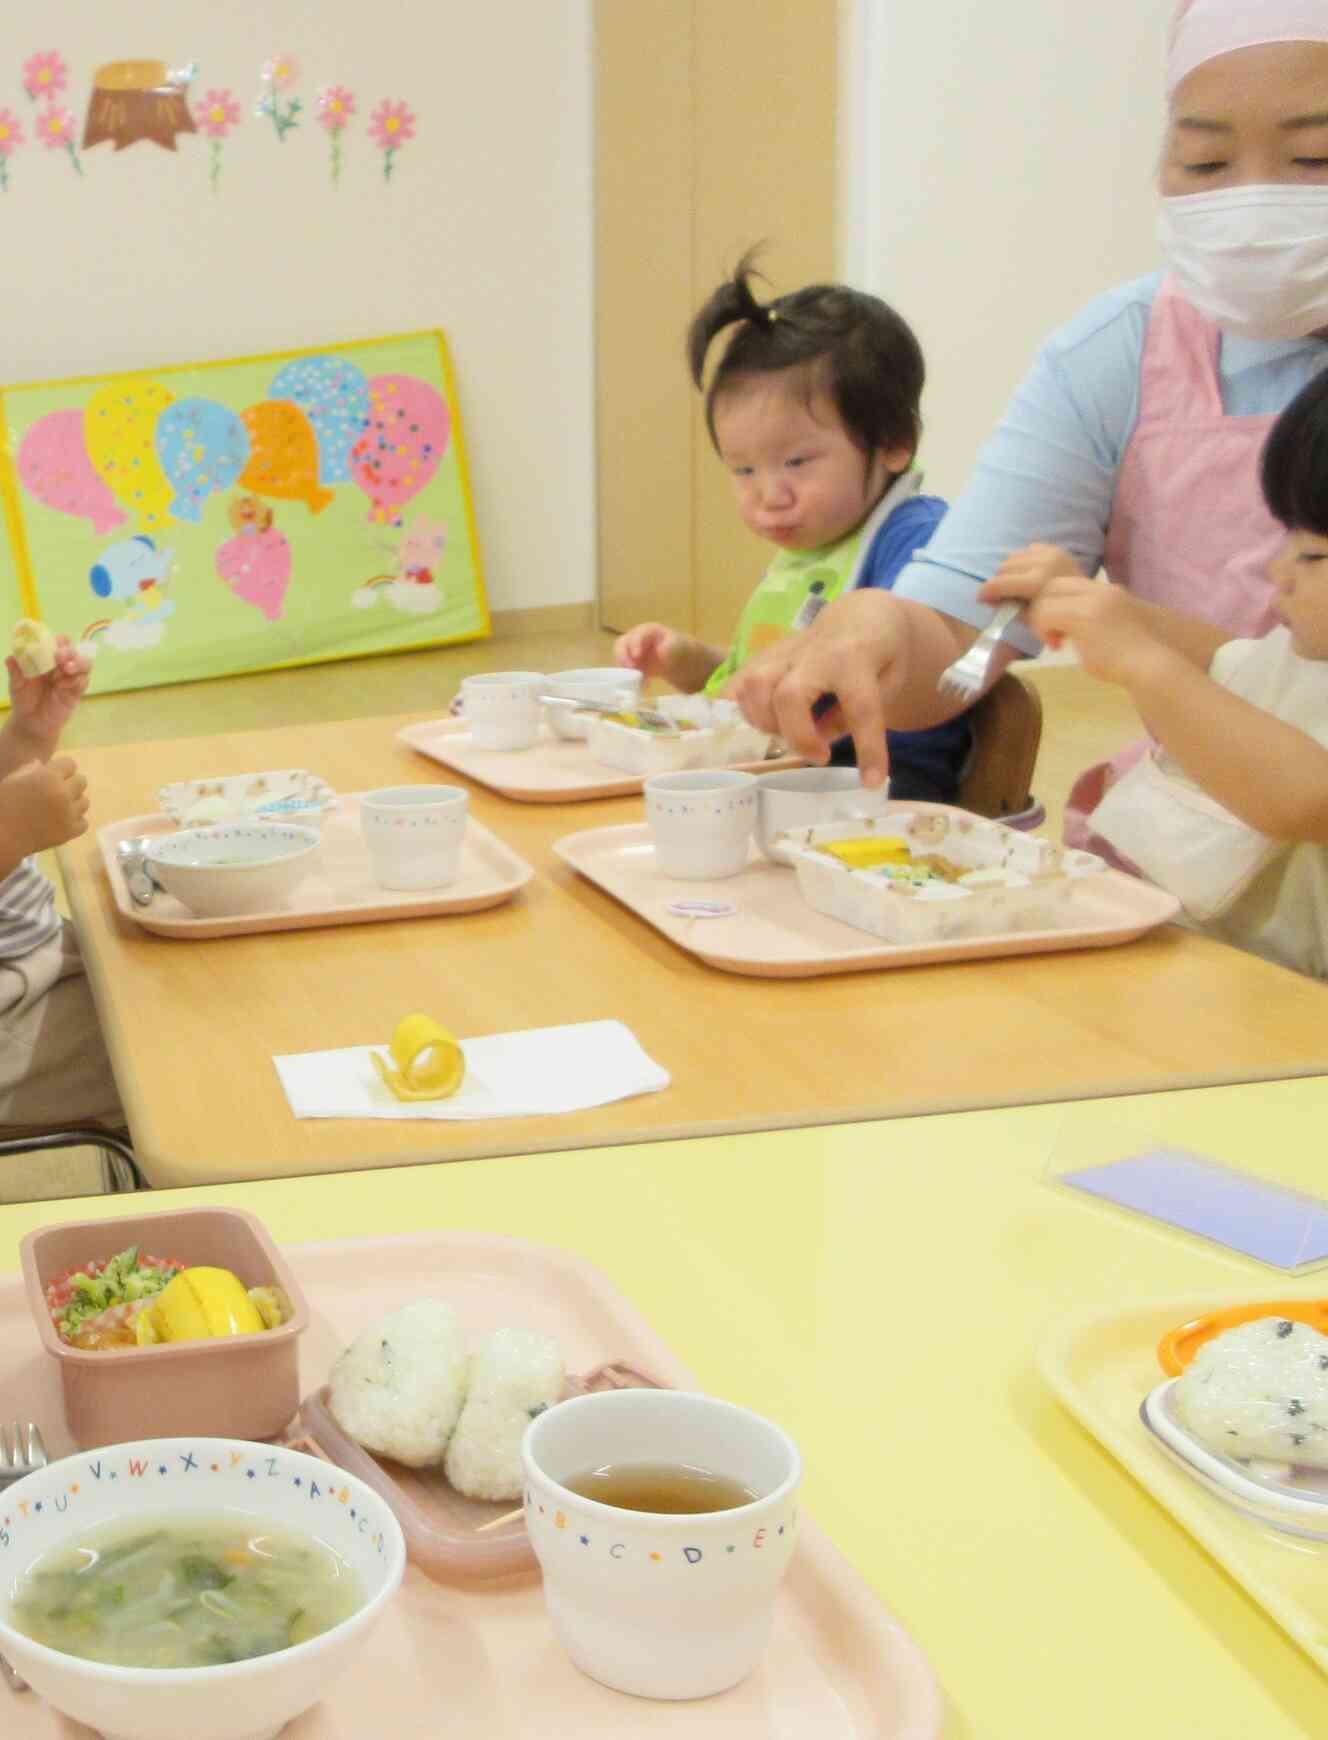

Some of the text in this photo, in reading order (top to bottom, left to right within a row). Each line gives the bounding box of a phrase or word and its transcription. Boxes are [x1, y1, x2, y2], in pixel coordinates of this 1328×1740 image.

[89, 1462, 102, 1480] V
[128, 1460, 148, 1477] W
[181, 1453, 199, 1472] X
[265, 1458, 280, 1477] Z
[609, 1543, 625, 1559] C
[683, 1547, 702, 1564] D
